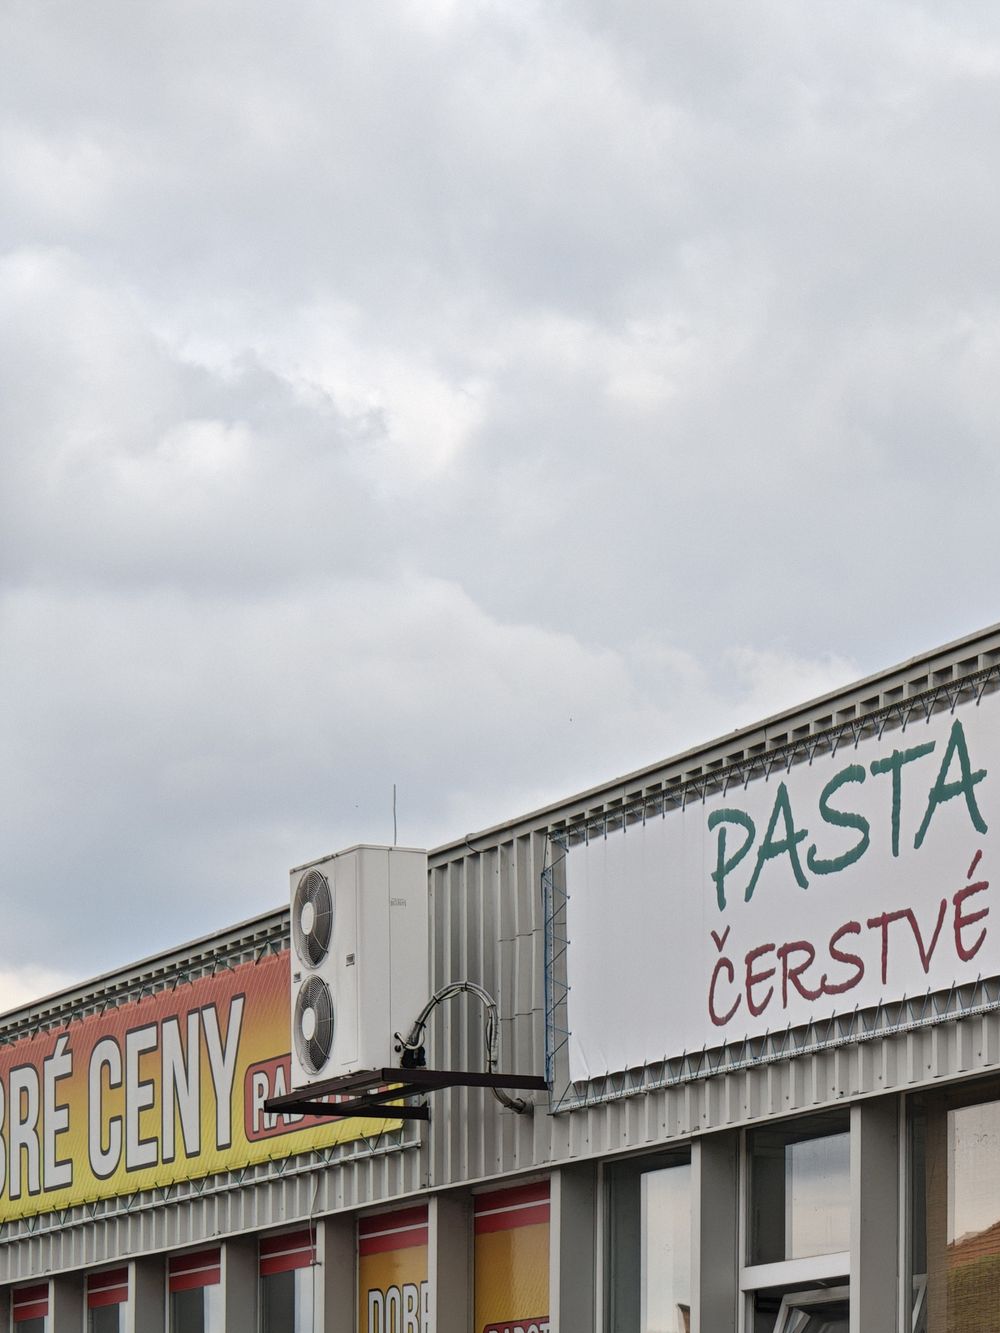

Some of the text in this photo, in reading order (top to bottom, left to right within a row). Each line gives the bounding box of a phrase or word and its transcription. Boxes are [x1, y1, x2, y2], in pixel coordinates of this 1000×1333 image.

[707, 718, 989, 912] PASTA
[707, 849, 989, 1027] ČERSTVÉ
[87, 993, 245, 1180] CENY
